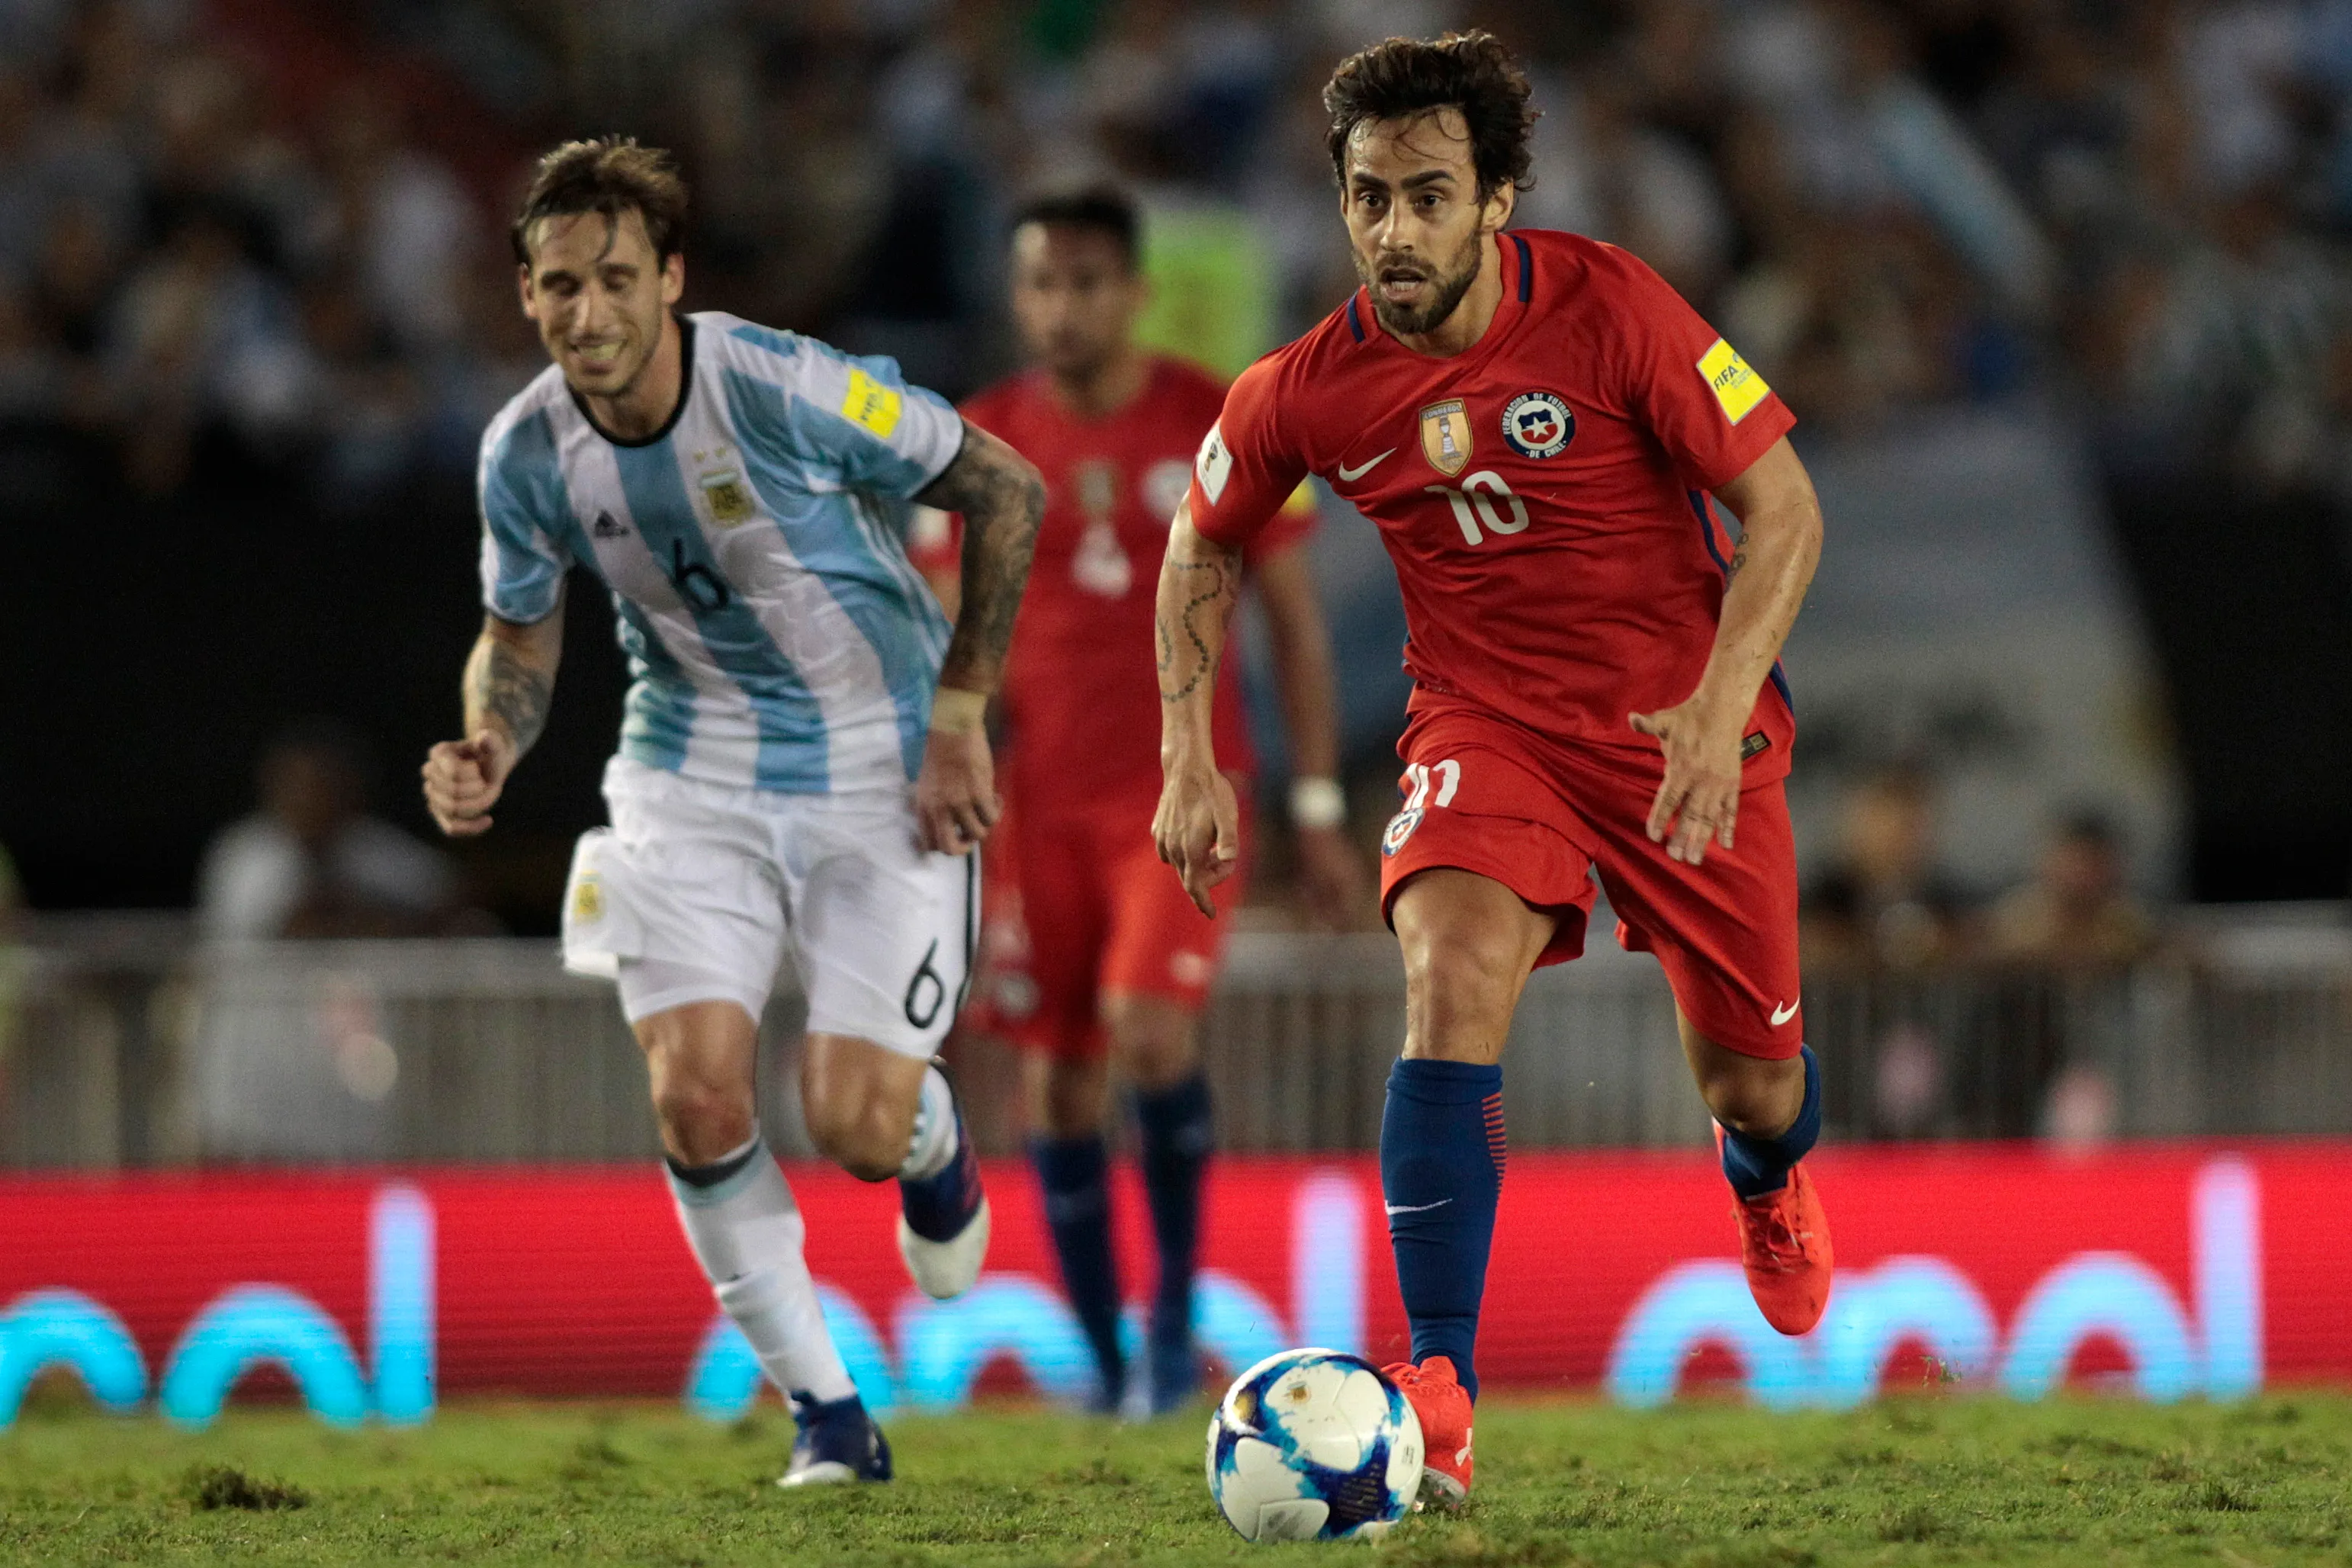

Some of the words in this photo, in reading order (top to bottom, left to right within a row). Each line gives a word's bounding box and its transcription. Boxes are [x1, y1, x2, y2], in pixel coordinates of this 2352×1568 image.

[1714, 365, 1738, 391] FIFA
[1424, 471, 1529, 546] 10
[673, 536, 728, 612] 6
[905, 936, 946, 1029] 6
